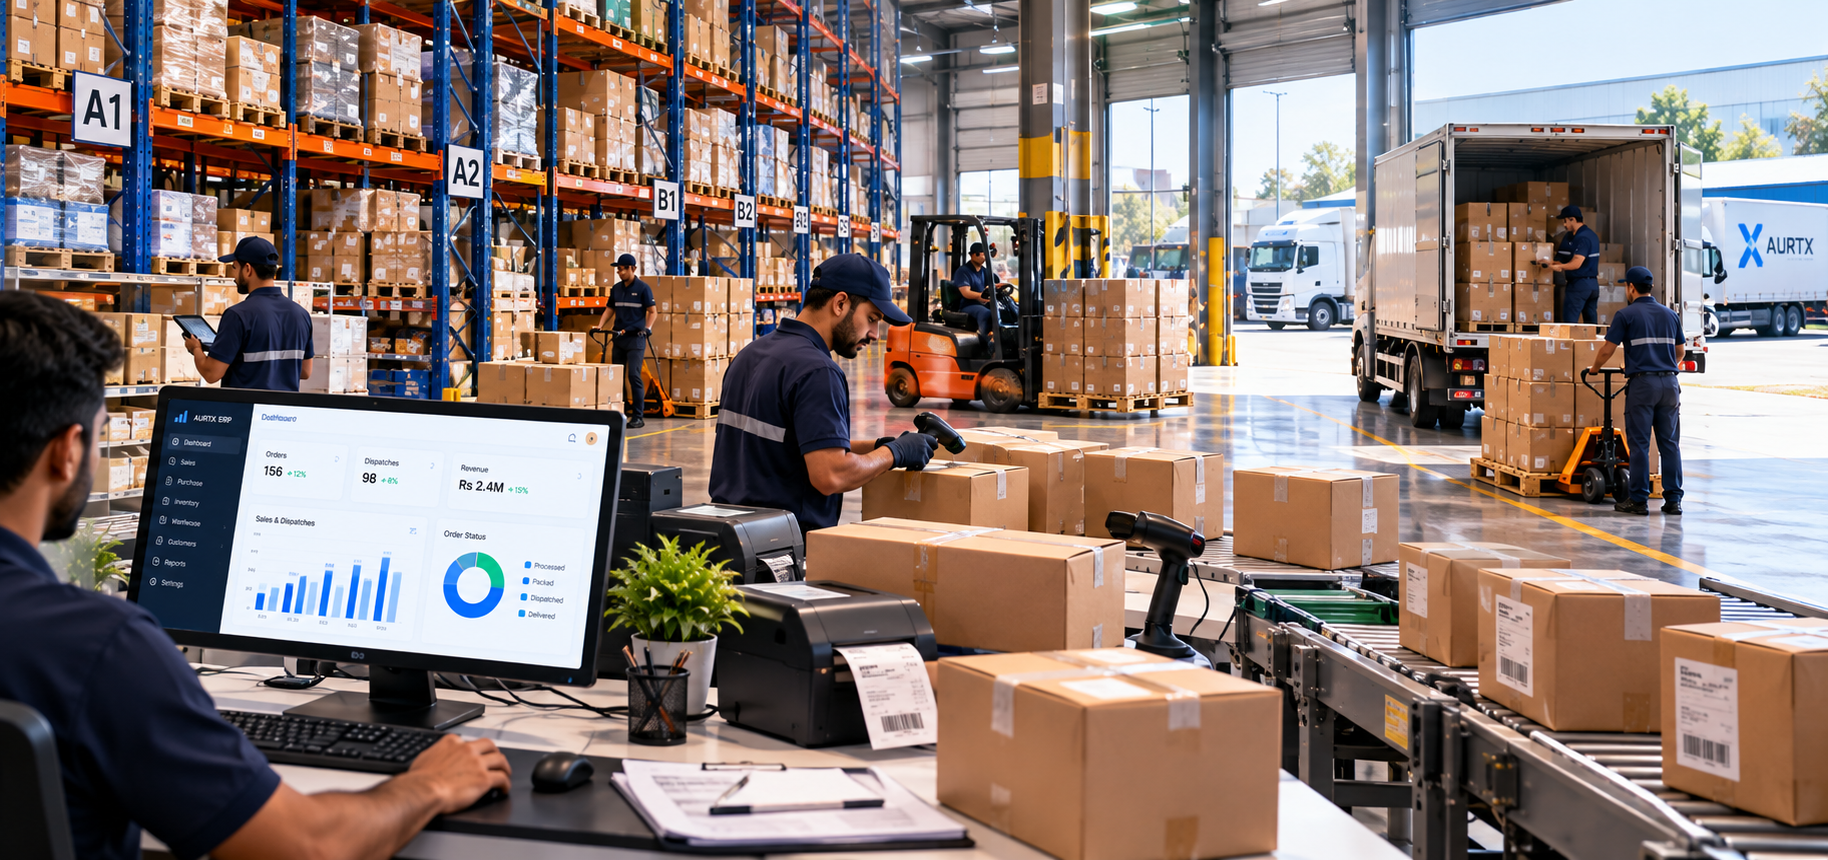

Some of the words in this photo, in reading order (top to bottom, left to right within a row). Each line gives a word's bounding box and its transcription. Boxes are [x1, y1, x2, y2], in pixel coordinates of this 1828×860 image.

[83, 88, 121, 130] A1
[452, 156, 480, 187] A2
[658, 188, 675, 212] B1
[737, 201, 753, 221] B2
[1766, 236, 1814, 255] AURTX
[193, 414, 216, 423] AURTX
[218, 416, 233, 424] ERP
[265, 450, 287, 459] Orders
[180, 458, 196, 466] Sales
[364, 457, 400, 467] Dispatches
[264, 465, 283, 477] 156
[460, 464, 489, 473] Revenue
[177, 478, 203, 487] Purchase
[362, 472, 377, 484] 98
[458, 479, 473, 491] Rs
[475, 480, 504, 493] 2.4M
[174, 498, 200, 508] Inventory
[255, 515, 273, 524] Sales
[274, 516, 279, 524] &
[280, 517, 316, 527] Dispatches
[443, 530, 463, 539] Order
[464, 532, 487, 541] Status
[167, 538, 197, 547] Customers
[164, 559, 186, 567] Reports
[533, 562, 566, 571] Processed
[161, 579, 184, 589] Settings
[530, 594, 564, 604] Dispatched
[528, 611, 556, 620] Delivered
